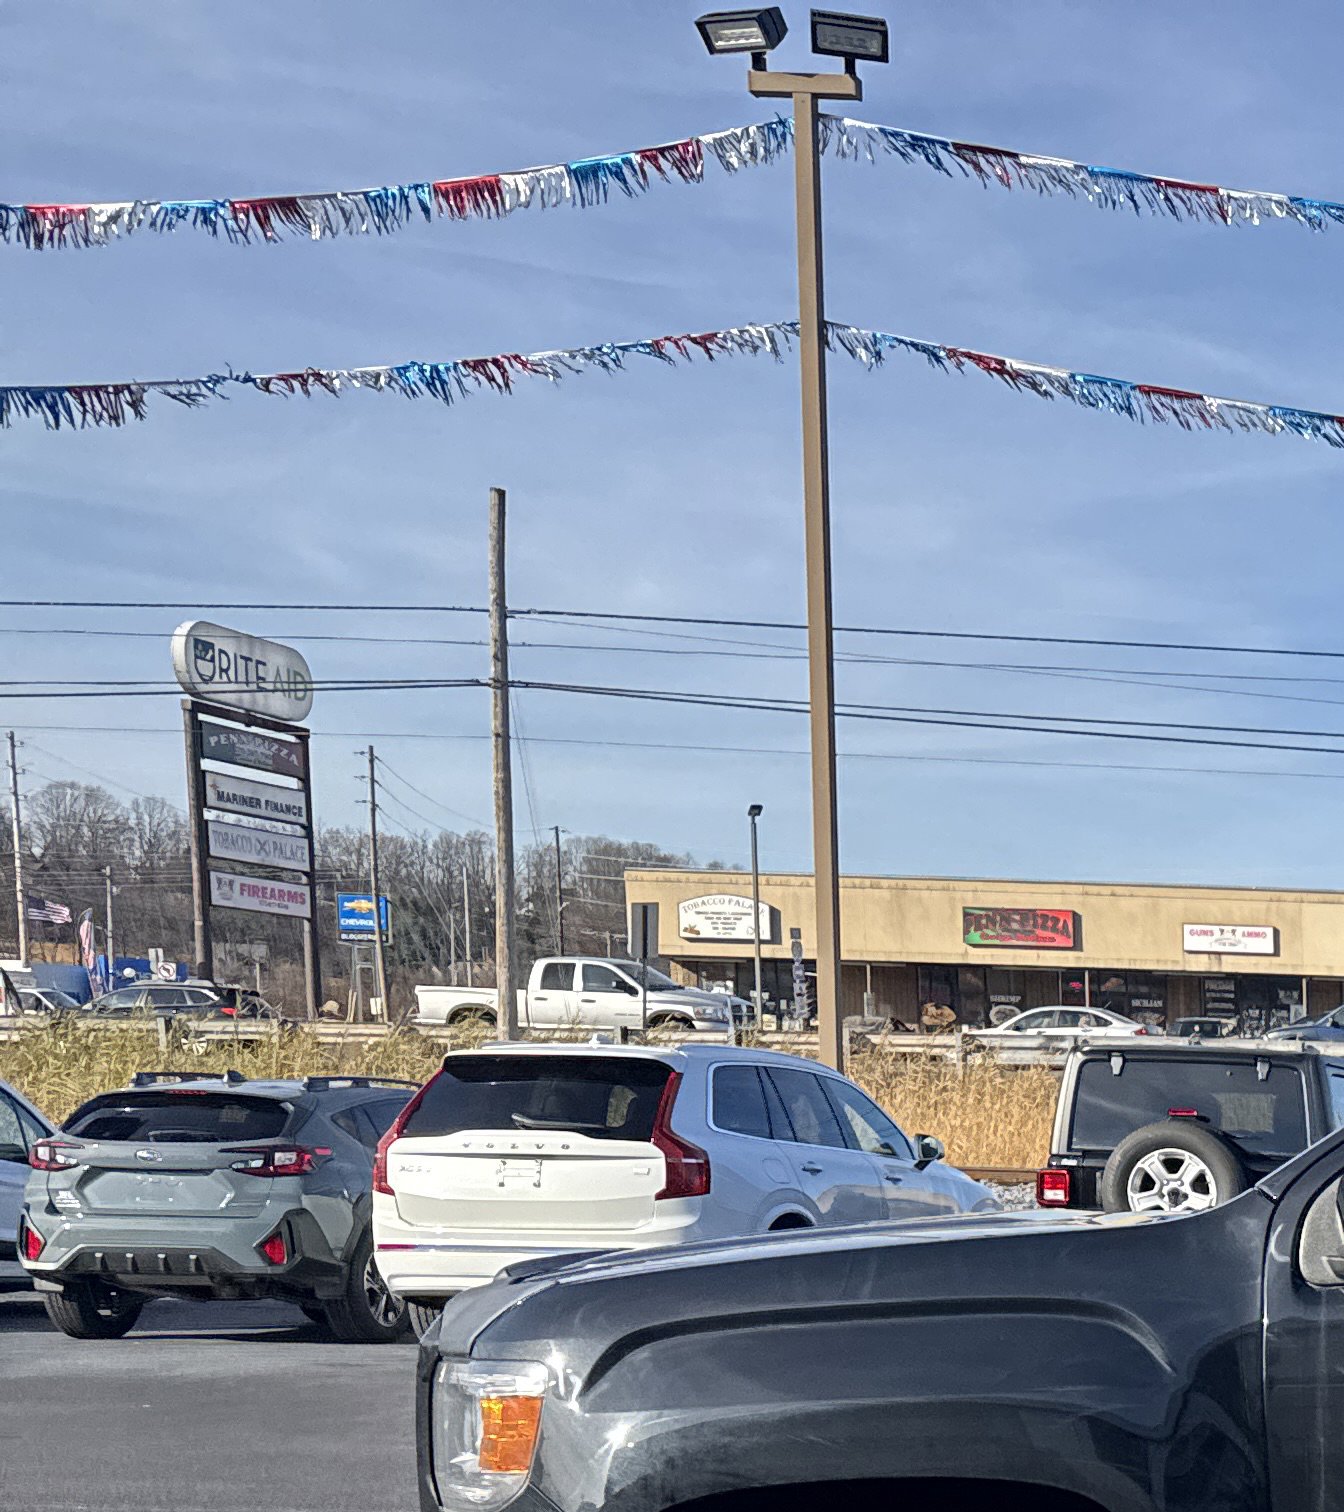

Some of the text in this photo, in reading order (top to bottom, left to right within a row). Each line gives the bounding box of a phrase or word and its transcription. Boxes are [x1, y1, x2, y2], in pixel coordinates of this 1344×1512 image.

[218, 648, 308, 701] RITE AID
[216, 789, 304, 818] MARINER FINANCE
[239, 882, 306, 905] FIREARMS
[682, 898, 766, 916] TOBACCO PALAE
[1189, 928, 1215, 937] GUNS
